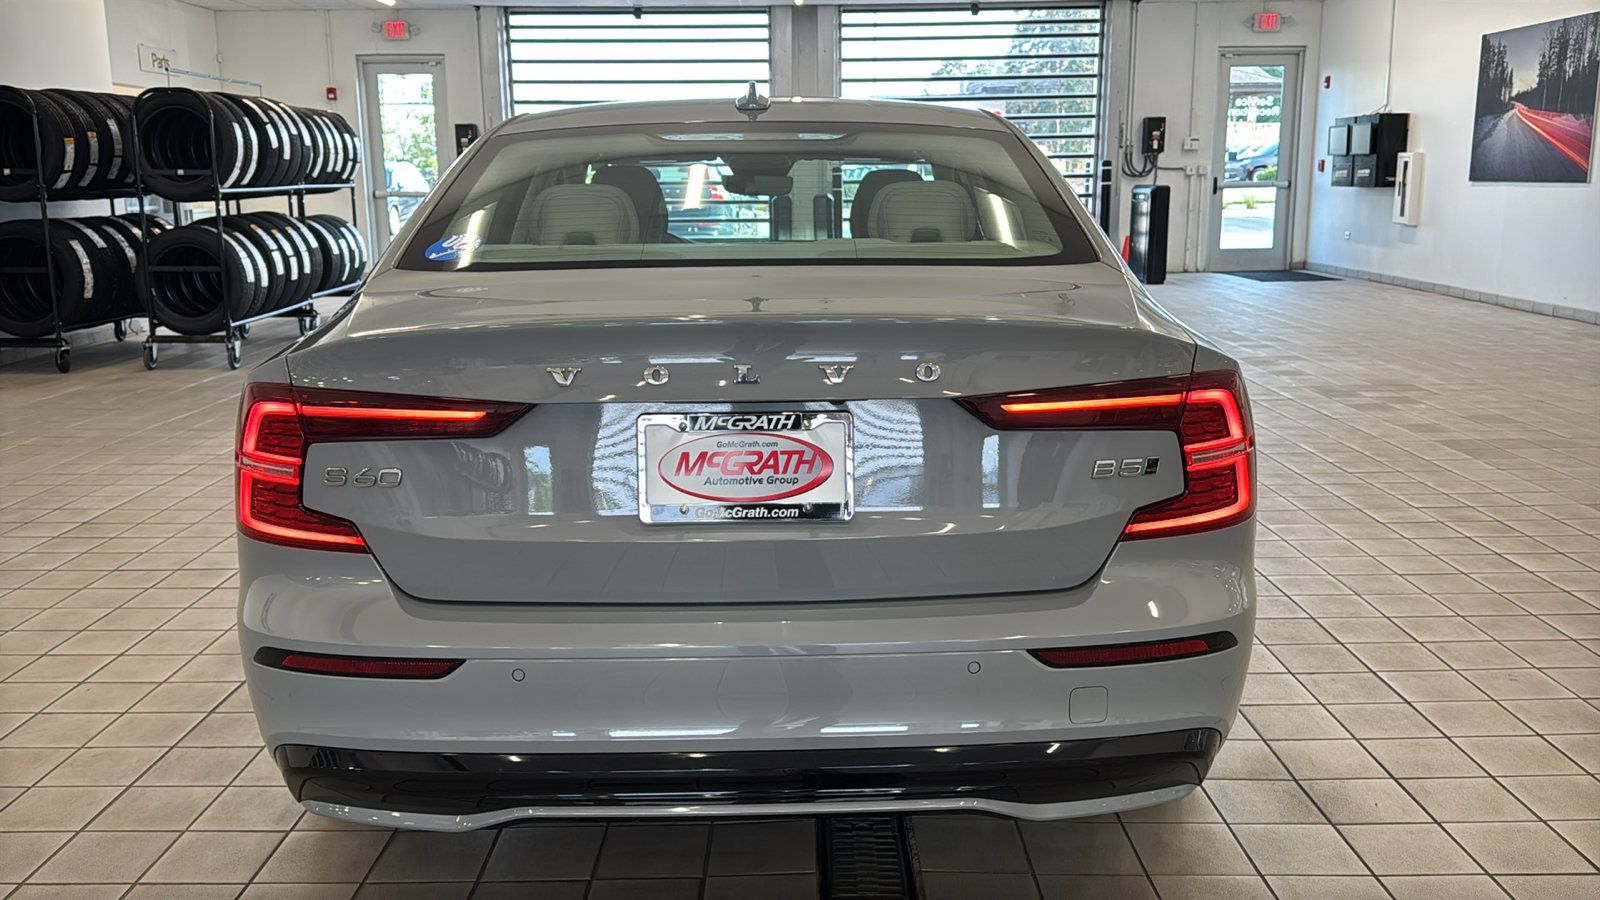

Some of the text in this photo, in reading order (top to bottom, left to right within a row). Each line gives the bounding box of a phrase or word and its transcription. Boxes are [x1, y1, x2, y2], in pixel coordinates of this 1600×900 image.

[385, 21, 406, 37] EXIT
[1258, 13, 1277, 29] EXIT
[546, 361, 942, 387] VOLVO
[716, 440, 778, 449] GoMcGrath.com
[323, 466, 403, 488] S60
[704, 475, 799, 486] Automotive Group
[695, 506, 799, 519] GoMcGrath.com
